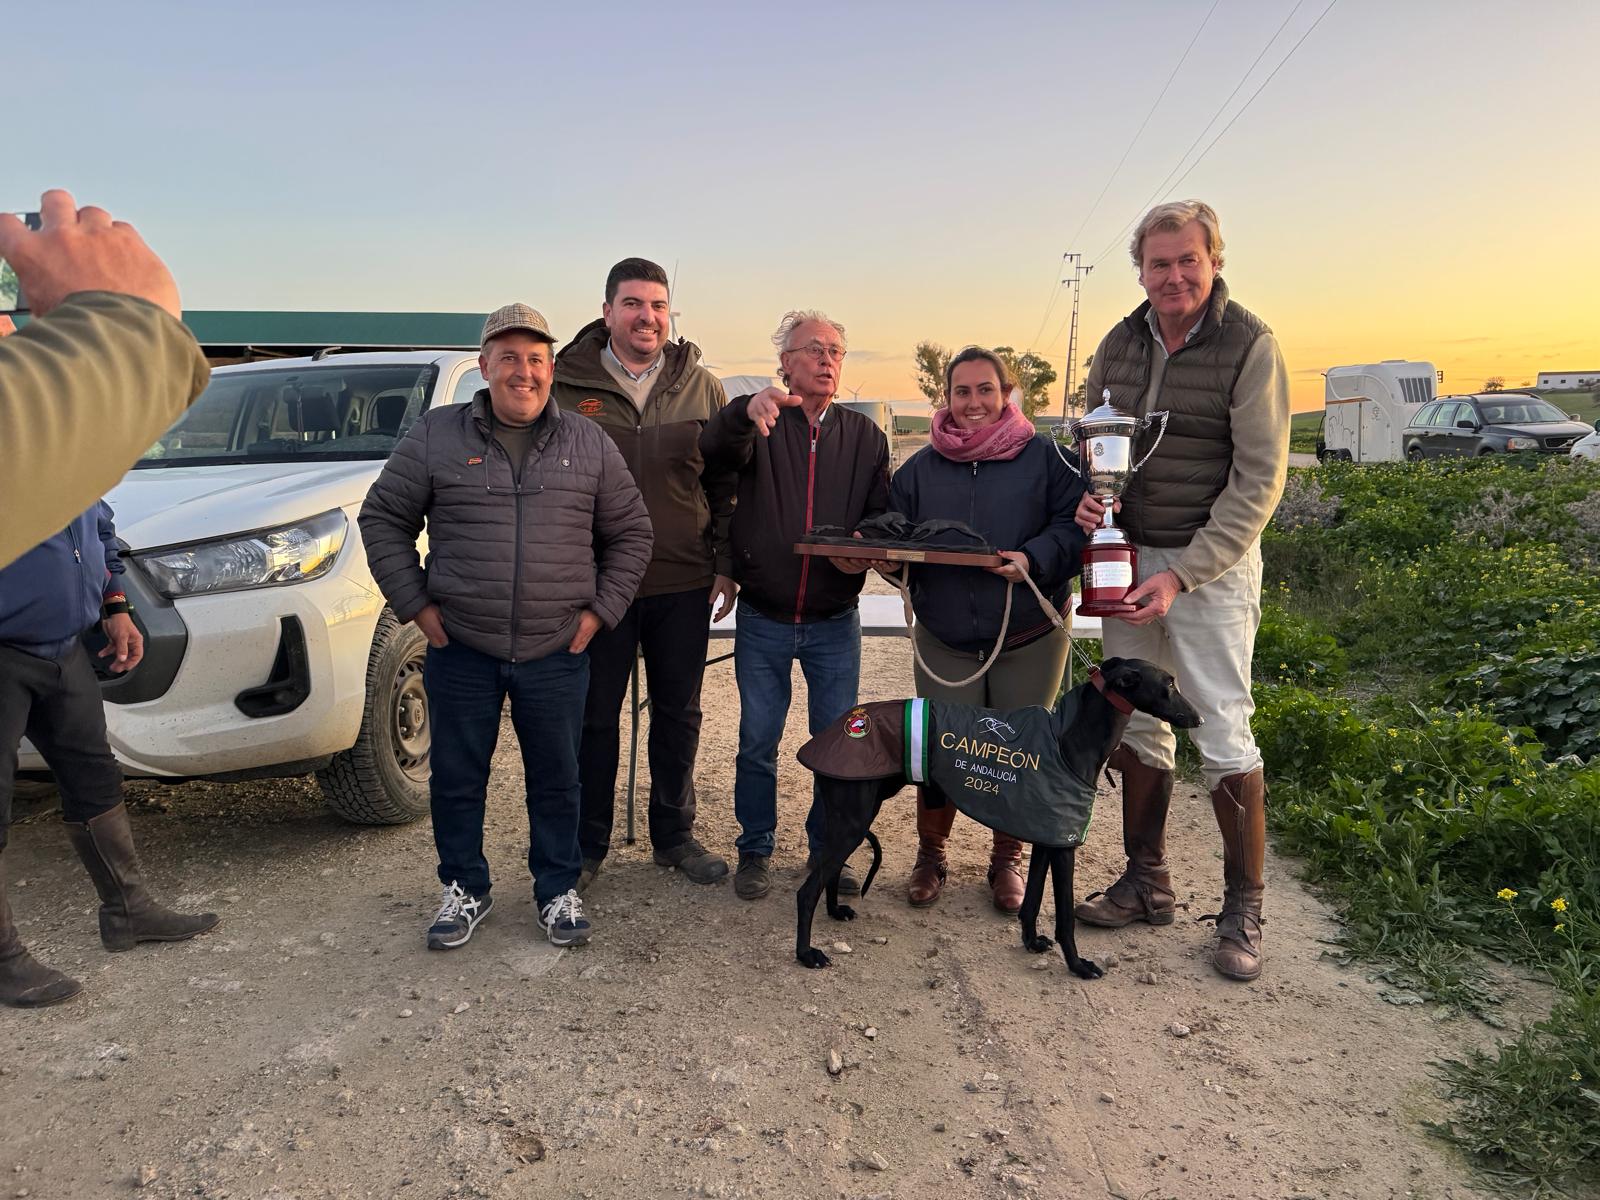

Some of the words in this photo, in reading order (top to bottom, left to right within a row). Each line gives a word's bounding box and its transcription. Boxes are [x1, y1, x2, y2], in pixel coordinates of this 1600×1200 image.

[941, 732, 1040, 771] CAMPEÓN
[955, 759, 968, 770] DE
[970, 763, 1017, 783] ANDALUCÍA
[964, 776, 1000, 795] 2024
